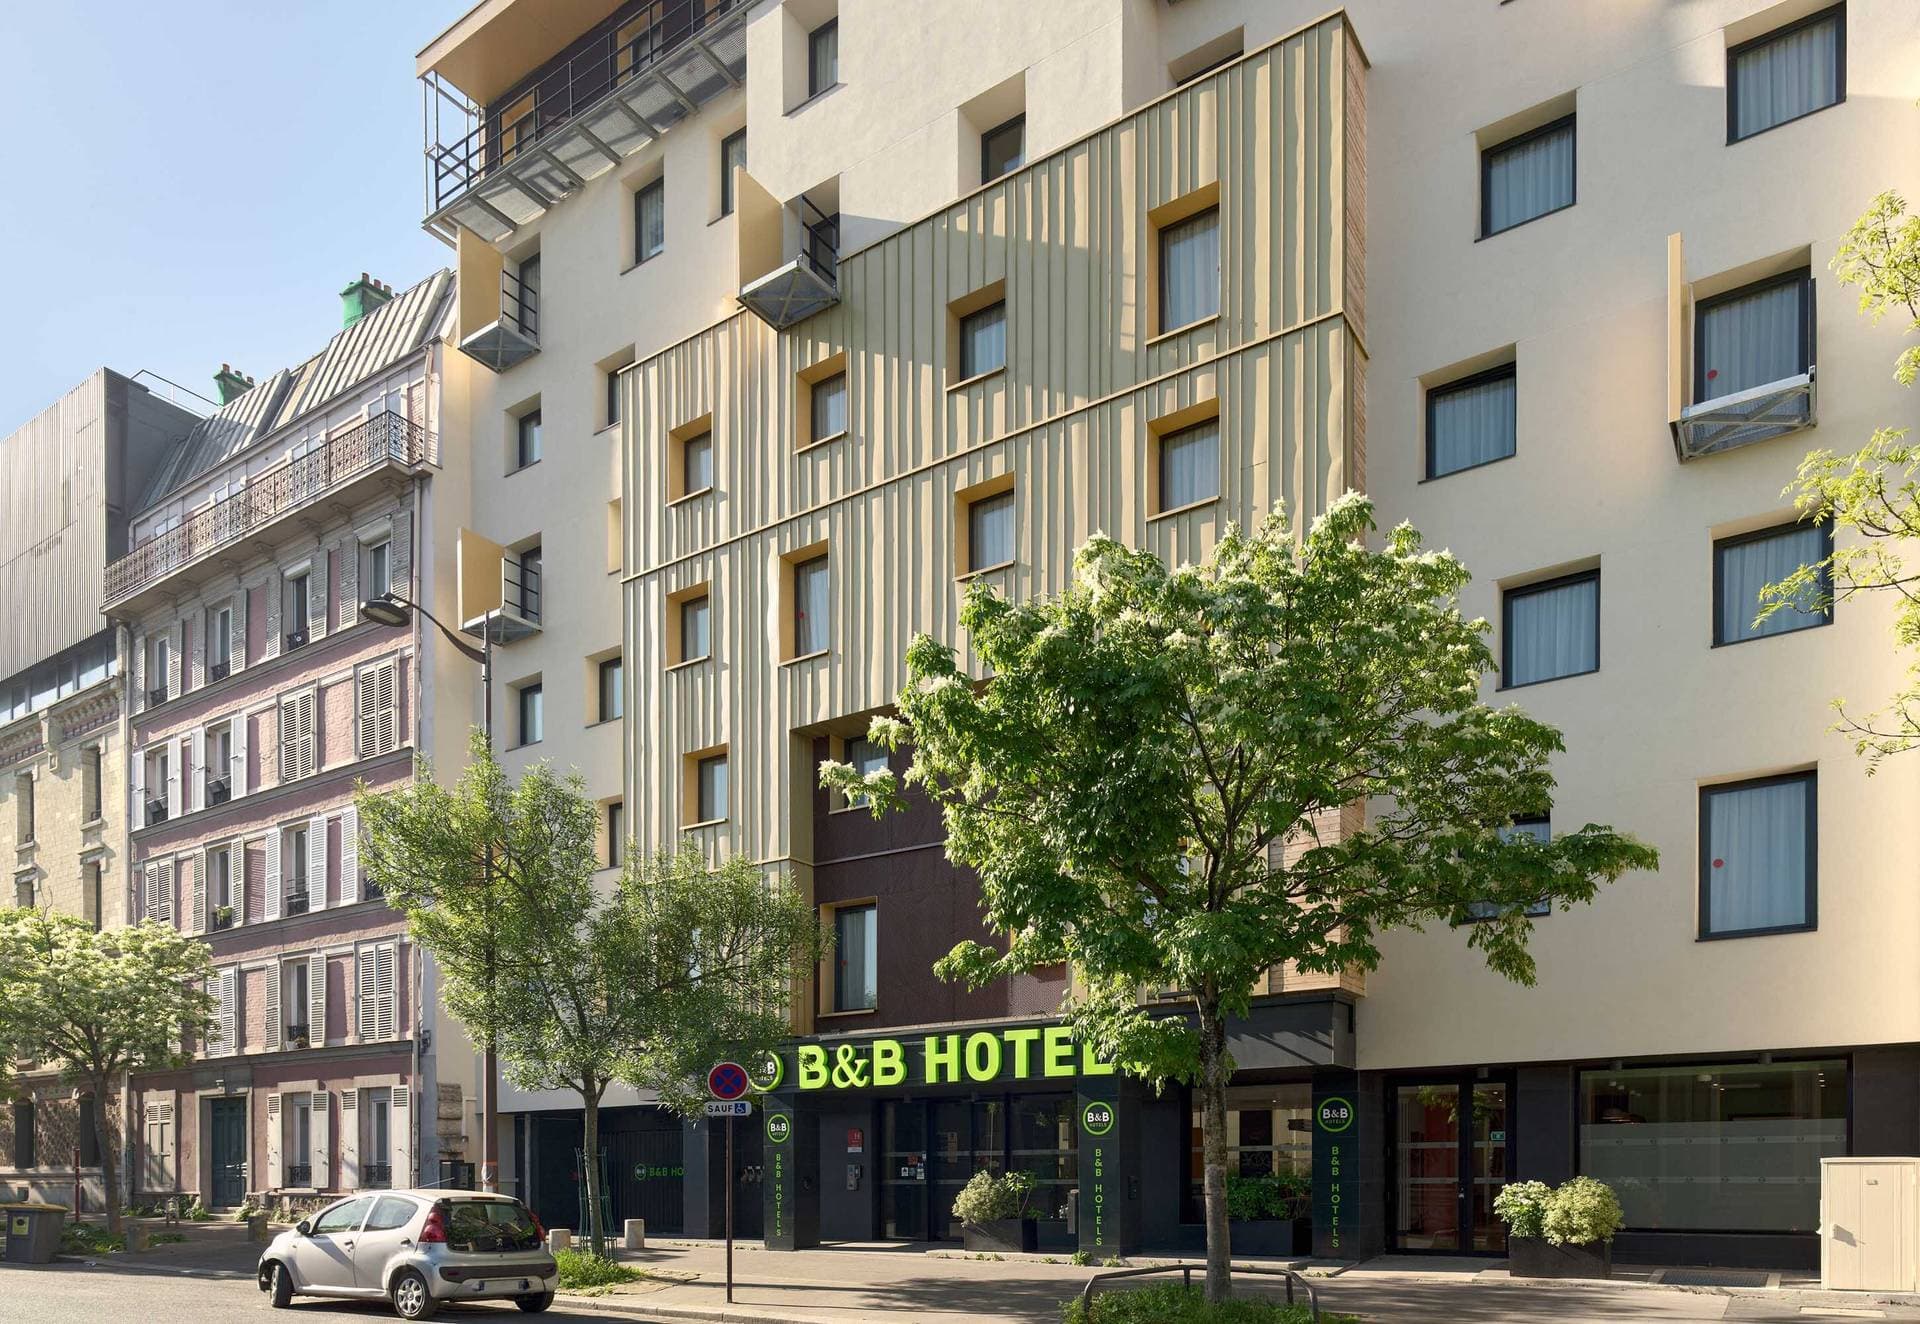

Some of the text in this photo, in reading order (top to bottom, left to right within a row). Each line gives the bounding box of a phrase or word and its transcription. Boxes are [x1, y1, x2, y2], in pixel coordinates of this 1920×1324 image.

[798, 1026, 1151, 1090] B&B HOTEL
[708, 1104, 733, 1113] SAUF
[1322, 1108, 1348, 1119] B&B
[1087, 1111, 1110, 1123] B&B
[770, 1122, 787, 1132] B&B
[649, 1167, 668, 1177] B&B
[775, 1153, 783, 1237] B&B HOTELS
[1094, 1148, 1103, 1246] B&B HOTELS
[1331, 1146, 1340, 1248] B&B HOTELS
